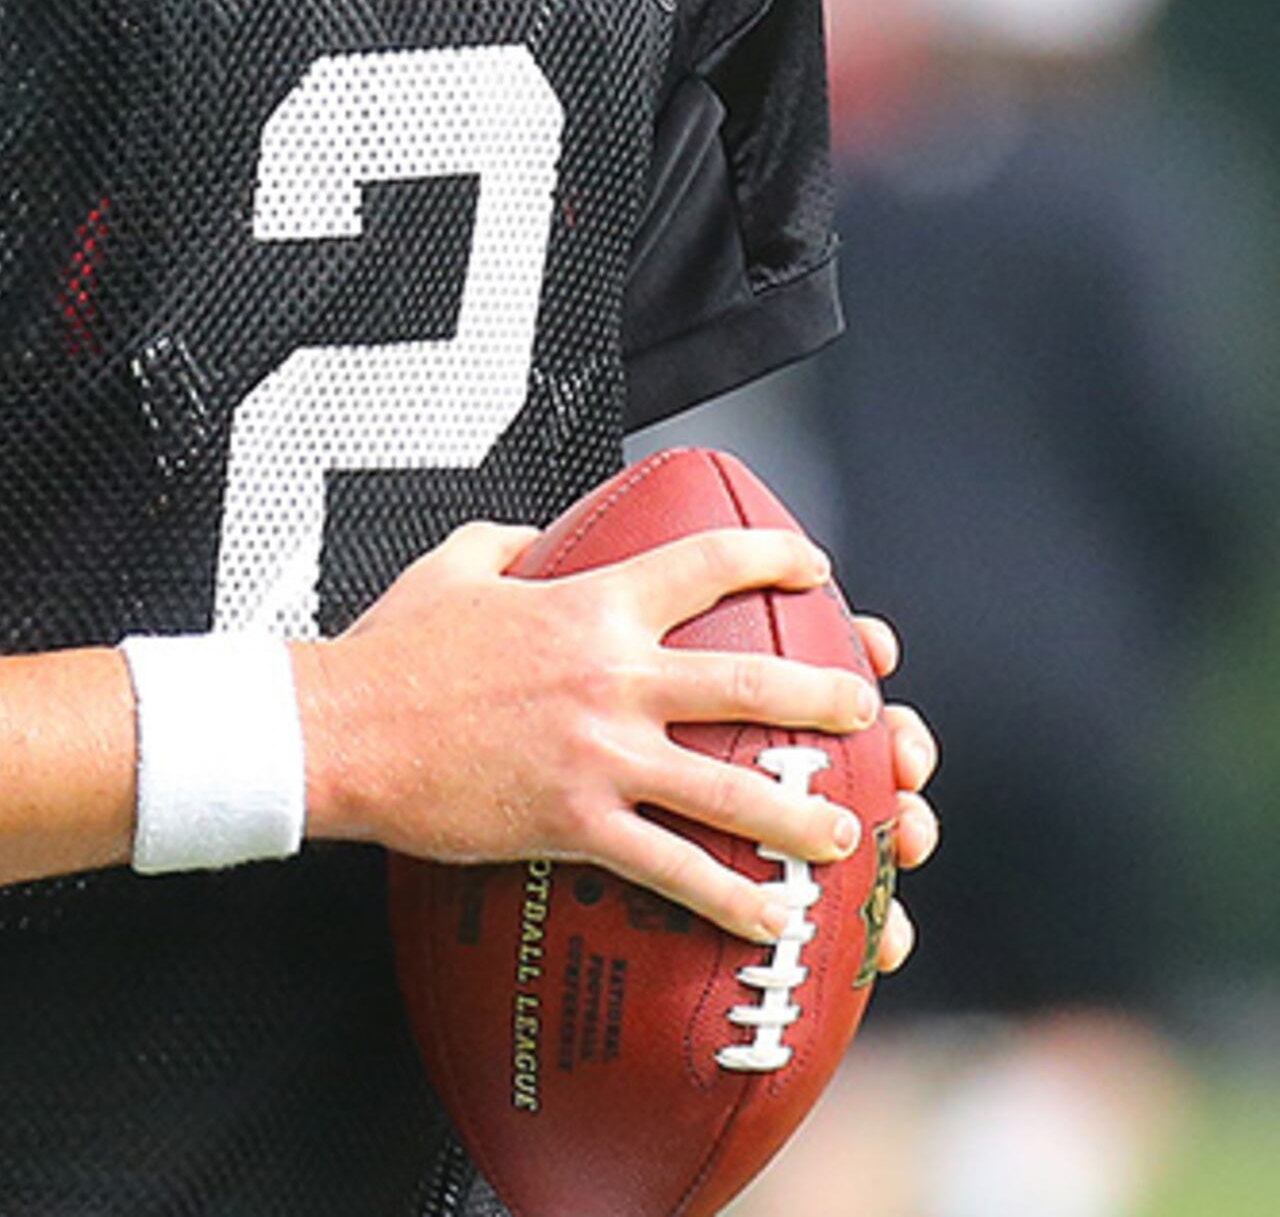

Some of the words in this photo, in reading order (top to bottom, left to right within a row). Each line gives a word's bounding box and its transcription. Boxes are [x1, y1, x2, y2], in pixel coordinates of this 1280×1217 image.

[211, 43, 567, 639] 2
[517, 859, 551, 984] OTBALL
[513, 993, 539, 1112] LEAGUE
